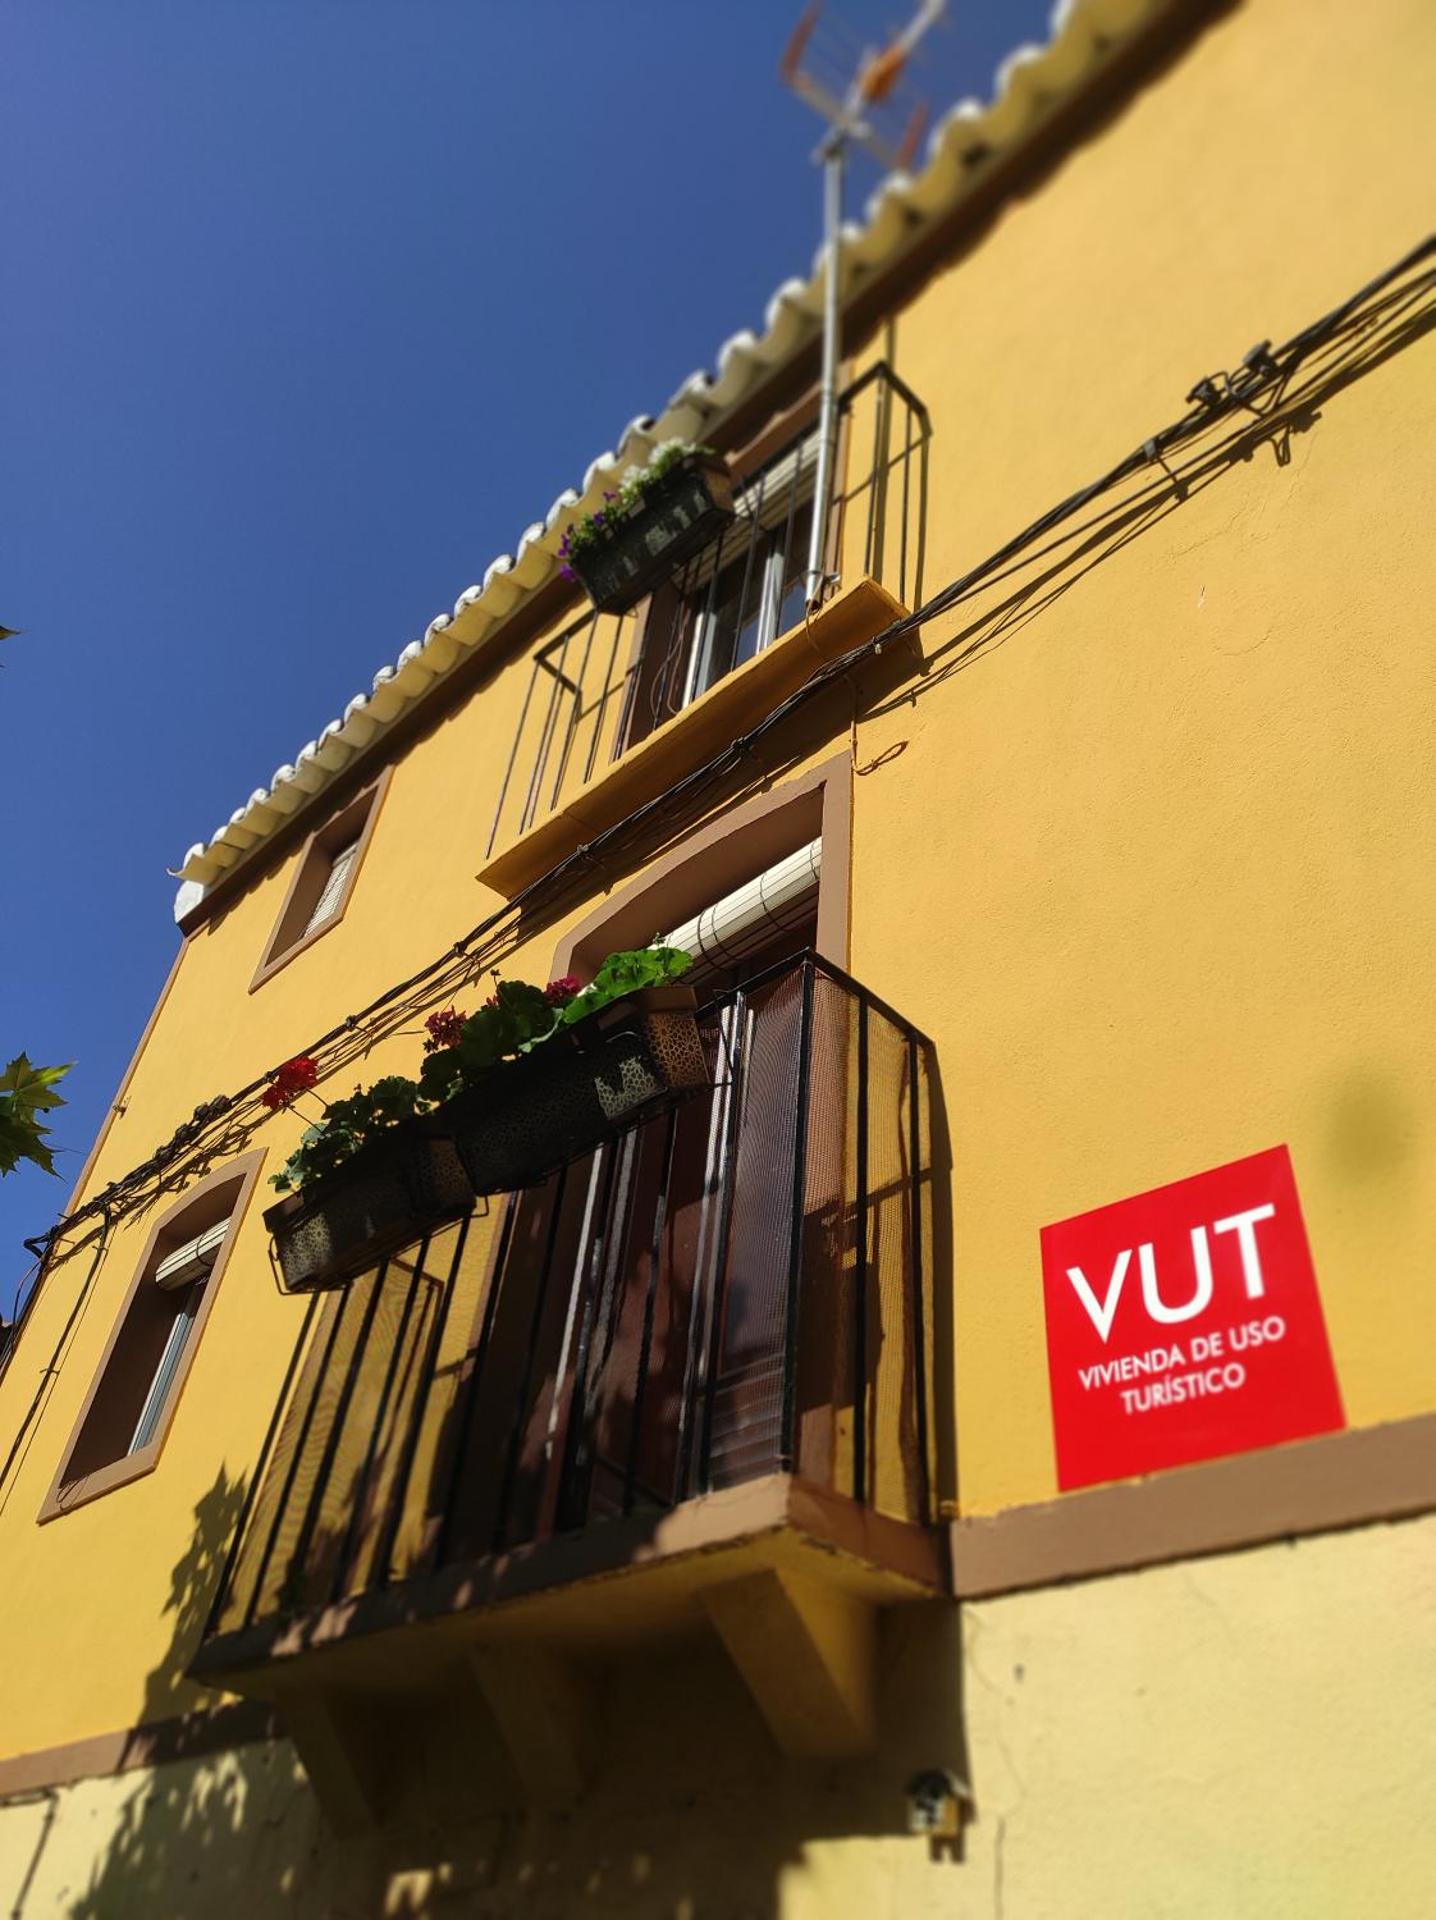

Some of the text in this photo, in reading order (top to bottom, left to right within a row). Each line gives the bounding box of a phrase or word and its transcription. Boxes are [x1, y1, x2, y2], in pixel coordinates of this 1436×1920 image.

[1065, 1202, 1276, 1344] VUT
[1078, 1315, 1286, 1390] VIVIENDA DE USO
[1120, 1362, 1246, 1414] TURÍSTICO
